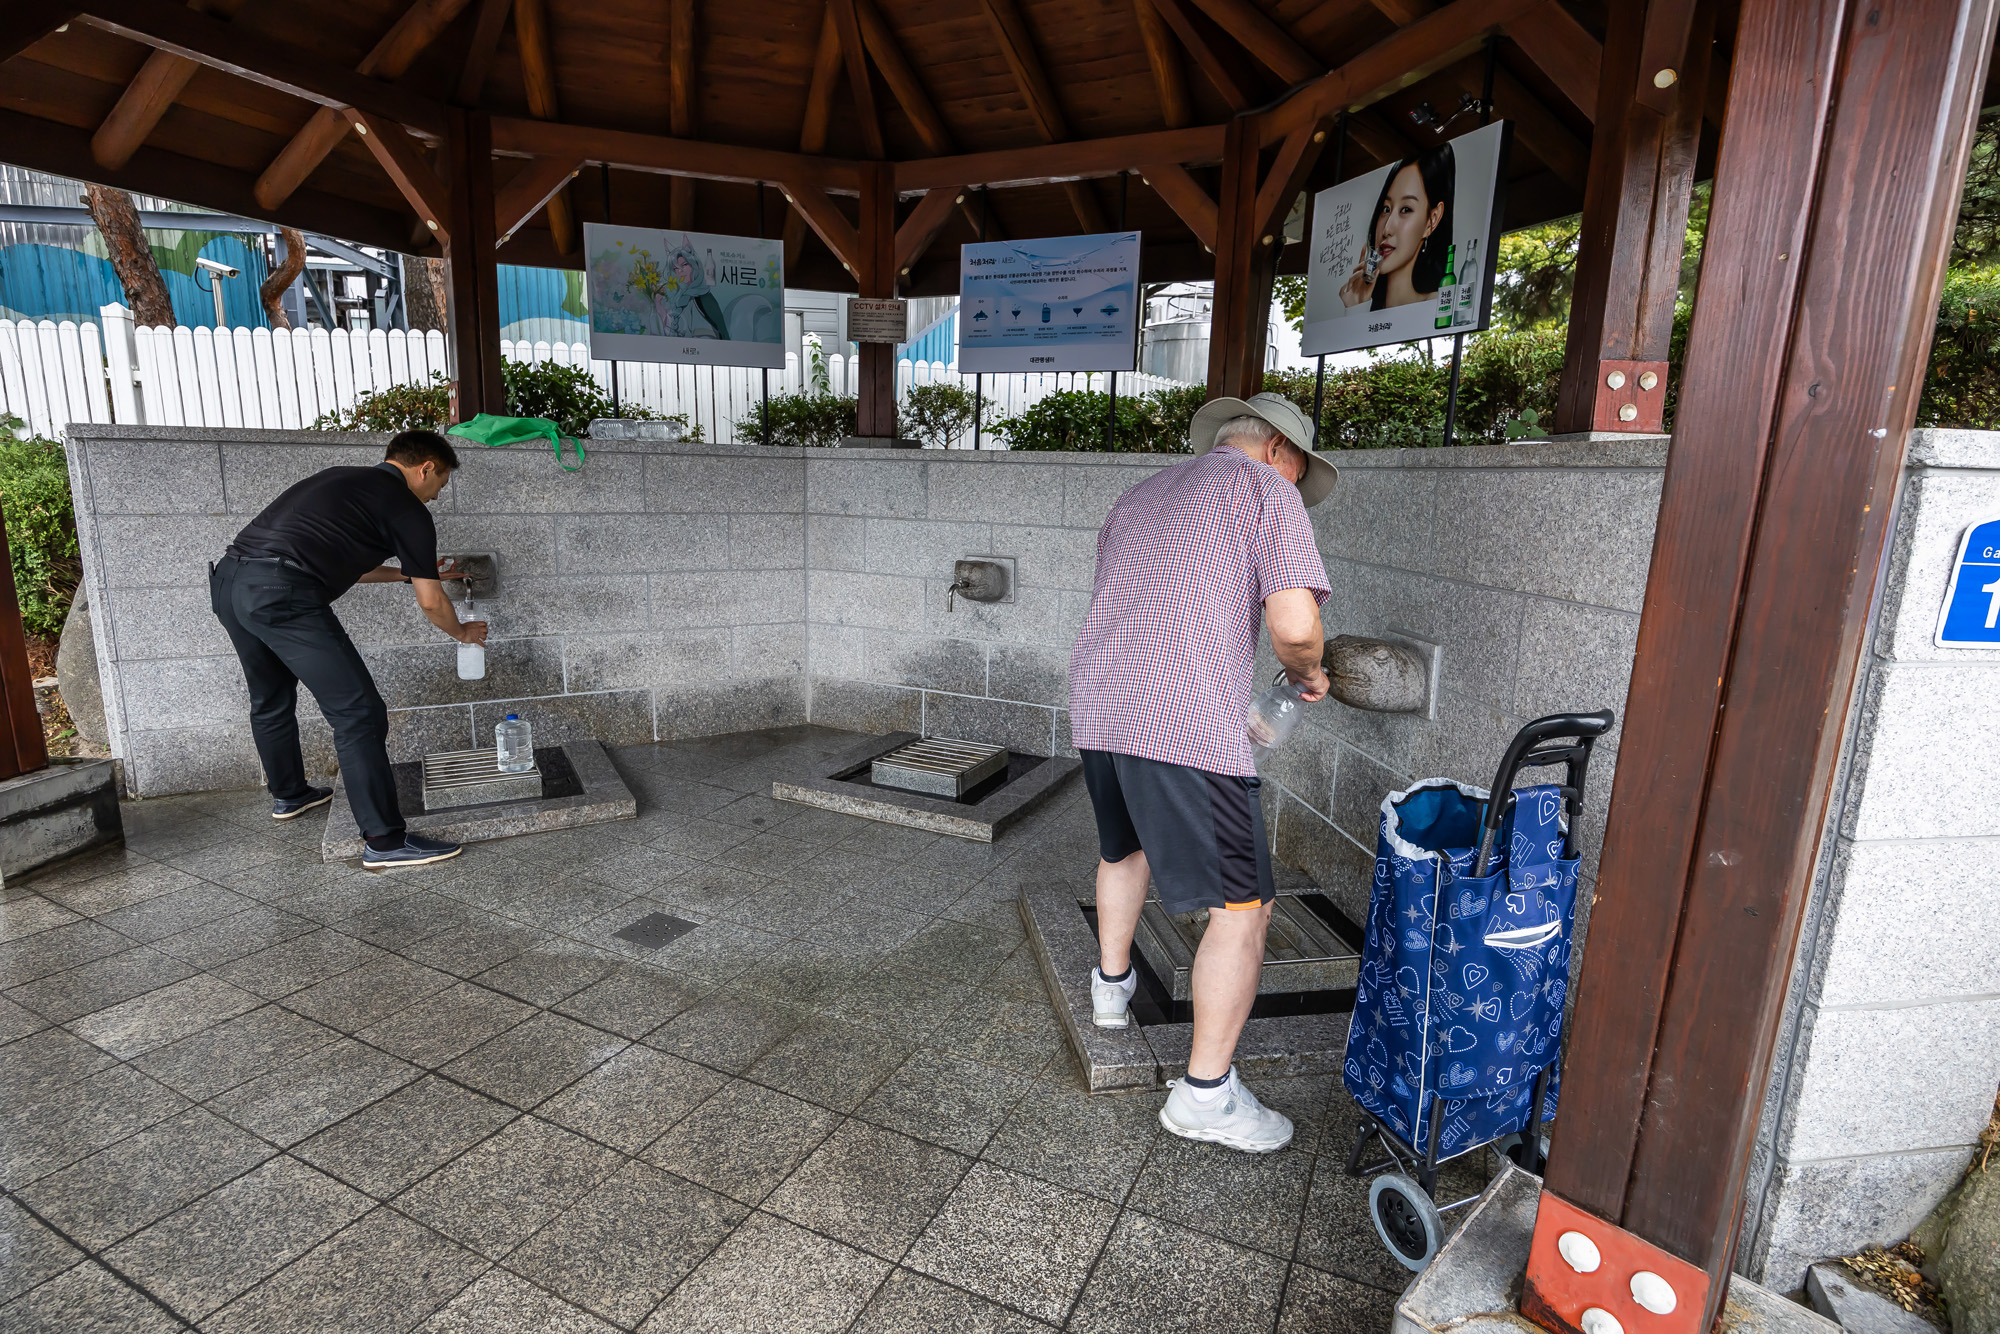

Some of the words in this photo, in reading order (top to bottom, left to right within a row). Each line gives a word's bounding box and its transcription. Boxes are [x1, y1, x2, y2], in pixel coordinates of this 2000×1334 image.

[1334, 202, 1352, 223] 우리의
[1326, 225, 1336, 239] 모든
[1336, 216, 1352, 235] 순간을
[969, 258, 996, 266] 처음처럼
[720, 266, 758, 286] 새로
[1441, 290, 1451, 298] 처음
[1368, 322, 1392, 333] 처음처럼
[682, 347, 697, 356] 새로
